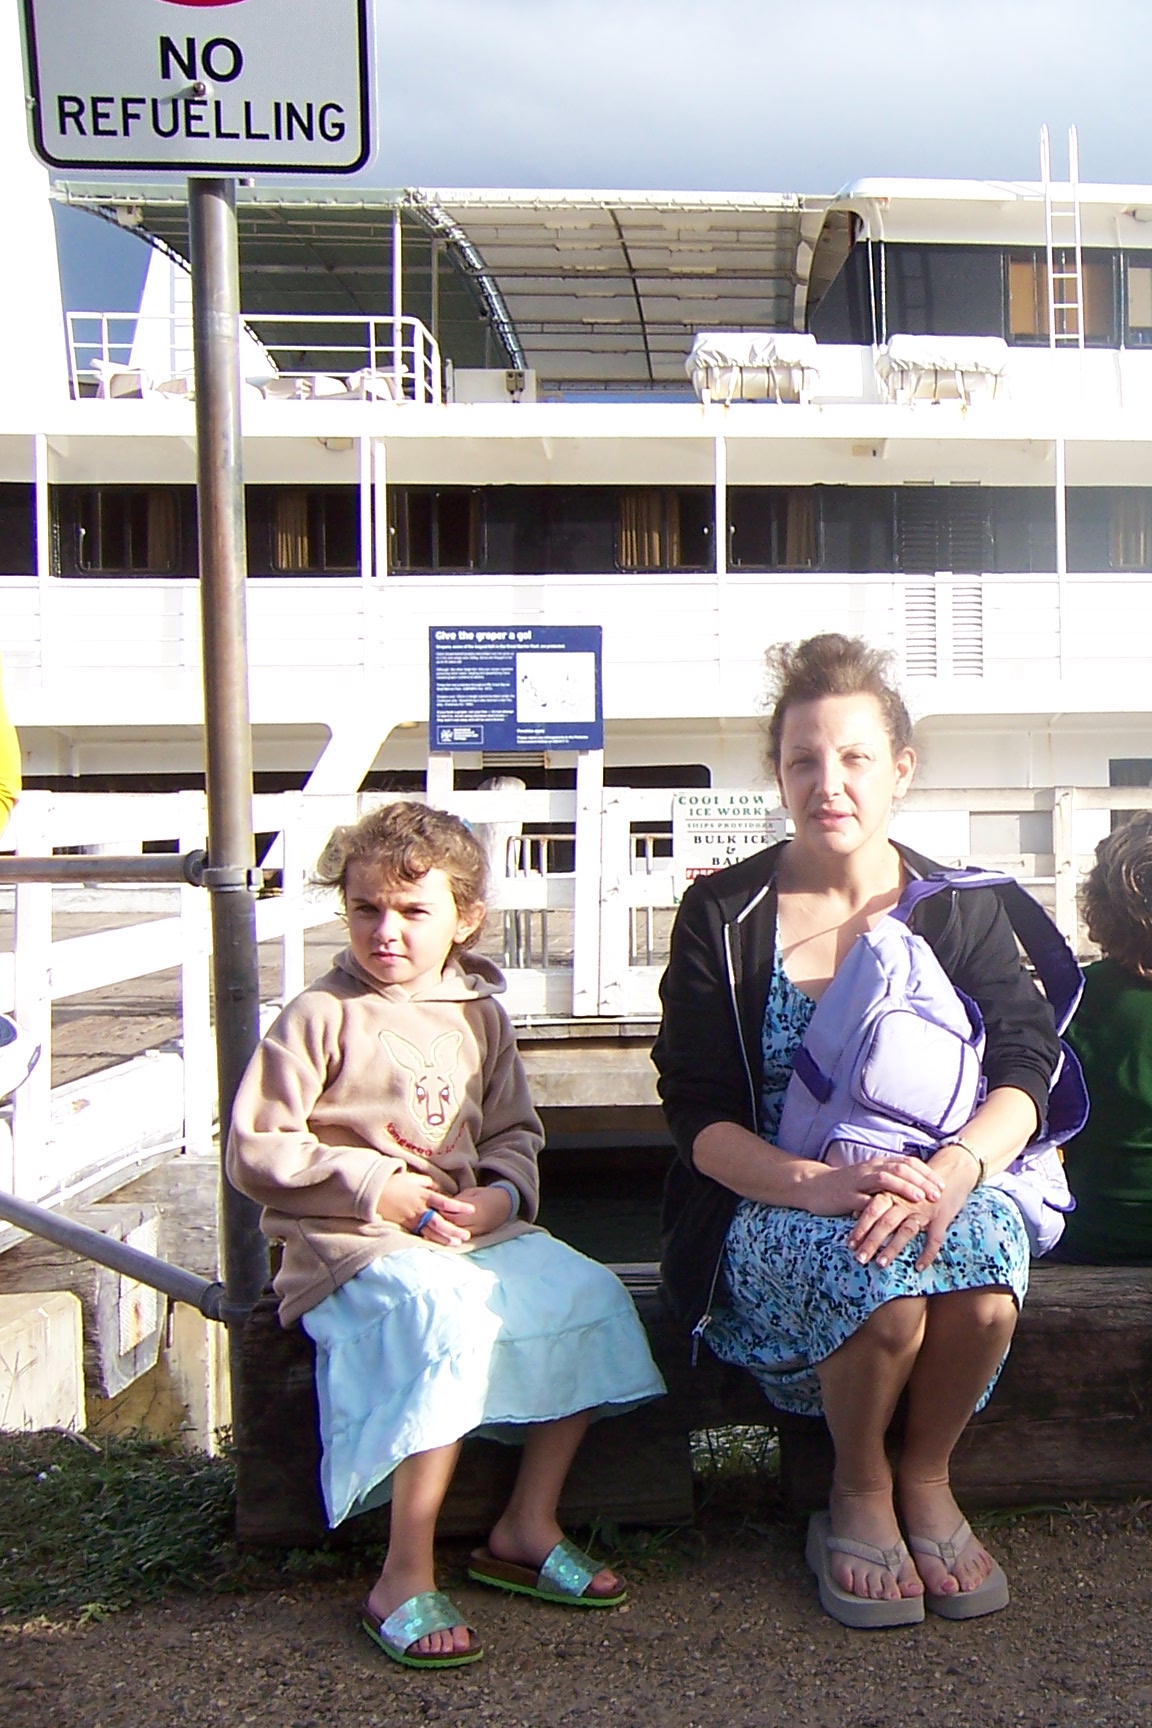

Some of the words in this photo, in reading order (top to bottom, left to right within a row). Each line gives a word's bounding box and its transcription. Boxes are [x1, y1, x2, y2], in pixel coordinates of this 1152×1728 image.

[159, 36, 244, 82] NO
[57, 95, 347, 142] REFUELLING
[435, 631, 456, 640] Give
[458, 631, 474, 640] the
[475, 632, 507, 642] groper
[508, 632, 516, 640] a
[517, 630, 532, 642] go!
[689, 807, 711, 816] ICE
[717, 807, 771, 816] WORKS
[693, 835, 737, 844] BULK
[743, 835, 770, 844] ICE
[725, 846, 737, 855] &
[711, 857, 747, 867] BAI
